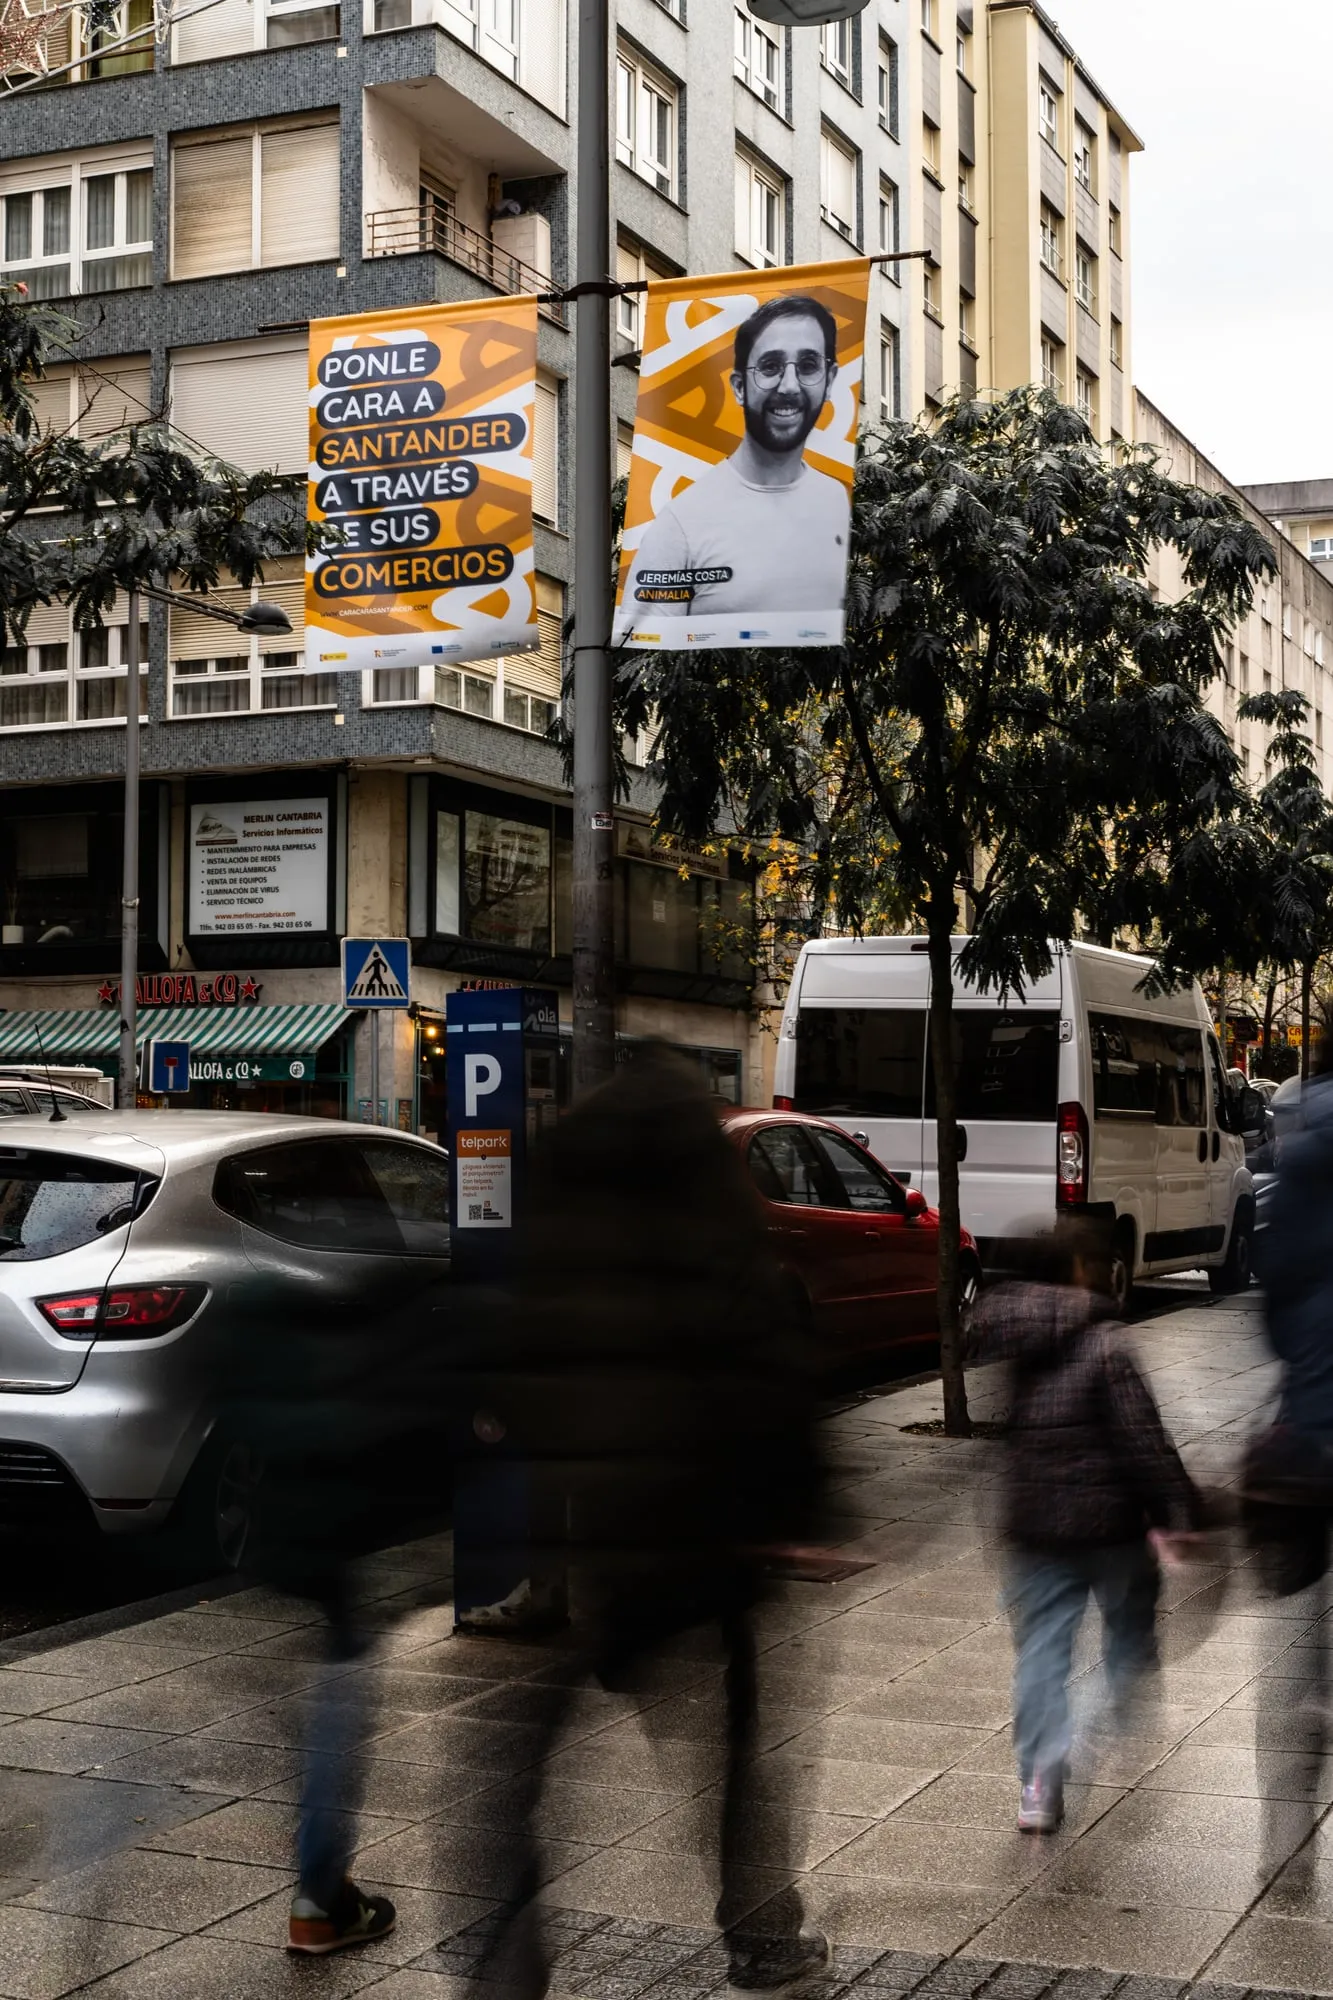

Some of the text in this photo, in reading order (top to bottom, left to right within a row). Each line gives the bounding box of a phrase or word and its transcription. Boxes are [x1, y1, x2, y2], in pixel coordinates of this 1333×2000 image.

[325, 347, 428, 383] PONLE
[323, 387, 435, 424] CARA A
[322, 419, 512, 466] SANTANDER
[321, 462, 471, 508] A TRAVÉS
[370, 518, 431, 545] SUS
[319, 549, 507, 592] COMERCIOS
[639, 569, 729, 584] JEREMÍAS COSTA
[637, 590, 691, 601] ANIMALIA
[243, 812, 323, 824] MERLIN CANTABRIA
[242, 827, 323, 838] Servicios Informáticos
[207, 843, 317, 854] MANTENIMIENTO PARA EMPRESAS
[206, 855, 250, 865] INSTALACIÓN
[260, 855, 281, 863] REDES
[206, 865, 277, 875] REDES INALÁMBRICAS
[206, 878, 228, 886] VENTA
[239, 876, 268, 885] EQUIPOS
[206, 887, 249, 896] ELIMINACIÓN
[260, 886, 280, 894] VIRUS
[206, 896, 264, 906] SERVICIO TÉCNICO
[214, 911, 296, 920] www.merlincantabria.com
[214, 923, 226, 931] 942
[272, 921, 285, 929] 942
[198, 983, 211, 1002] &
[537, 1007, 557, 1023] ola
[188, 1061, 224, 1080] ALLOFA
[225, 1067, 234, 1080] &
[464, 1053, 502, 1117] P
[461, 1136, 508, 1152] telpark
